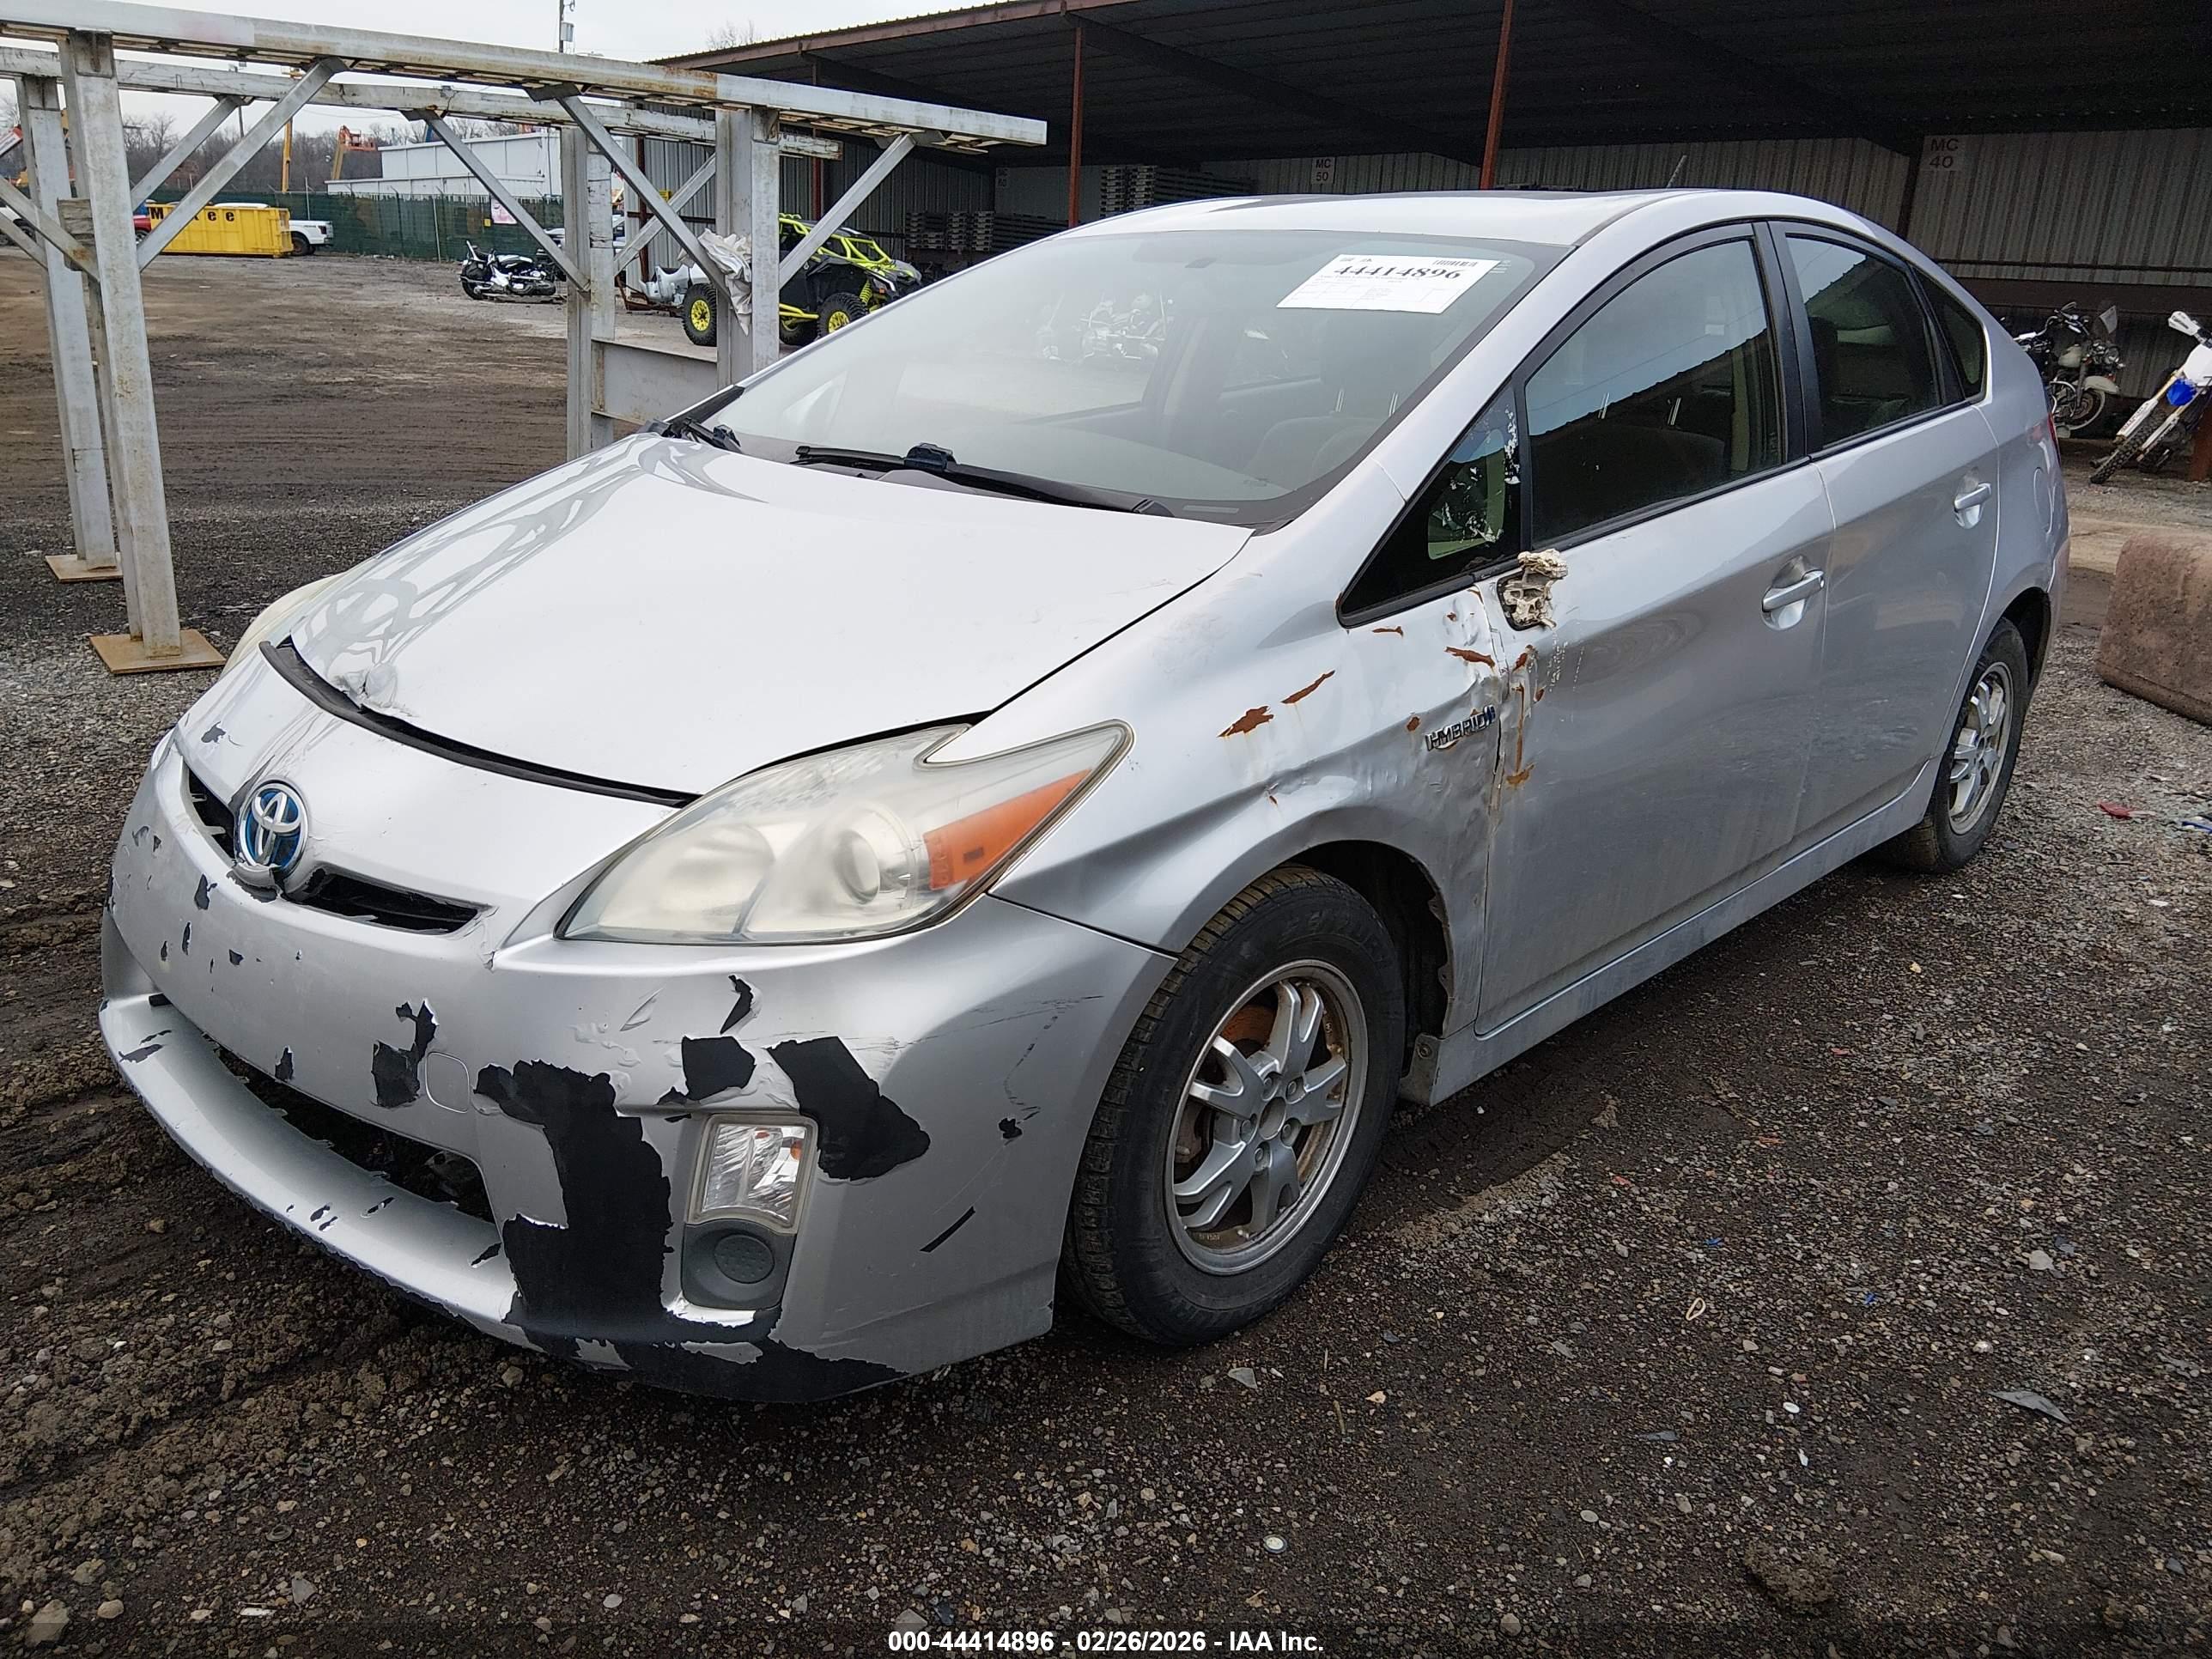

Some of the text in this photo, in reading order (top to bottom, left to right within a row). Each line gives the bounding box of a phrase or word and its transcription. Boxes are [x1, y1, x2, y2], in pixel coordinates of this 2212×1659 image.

[1930, 138, 1959, 151] MC
[1316, 158, 1331, 168] MC
[1929, 155, 1954, 168] 40
[1316, 172, 1328, 181] 50
[1334, 265, 1464, 279] 44414896
